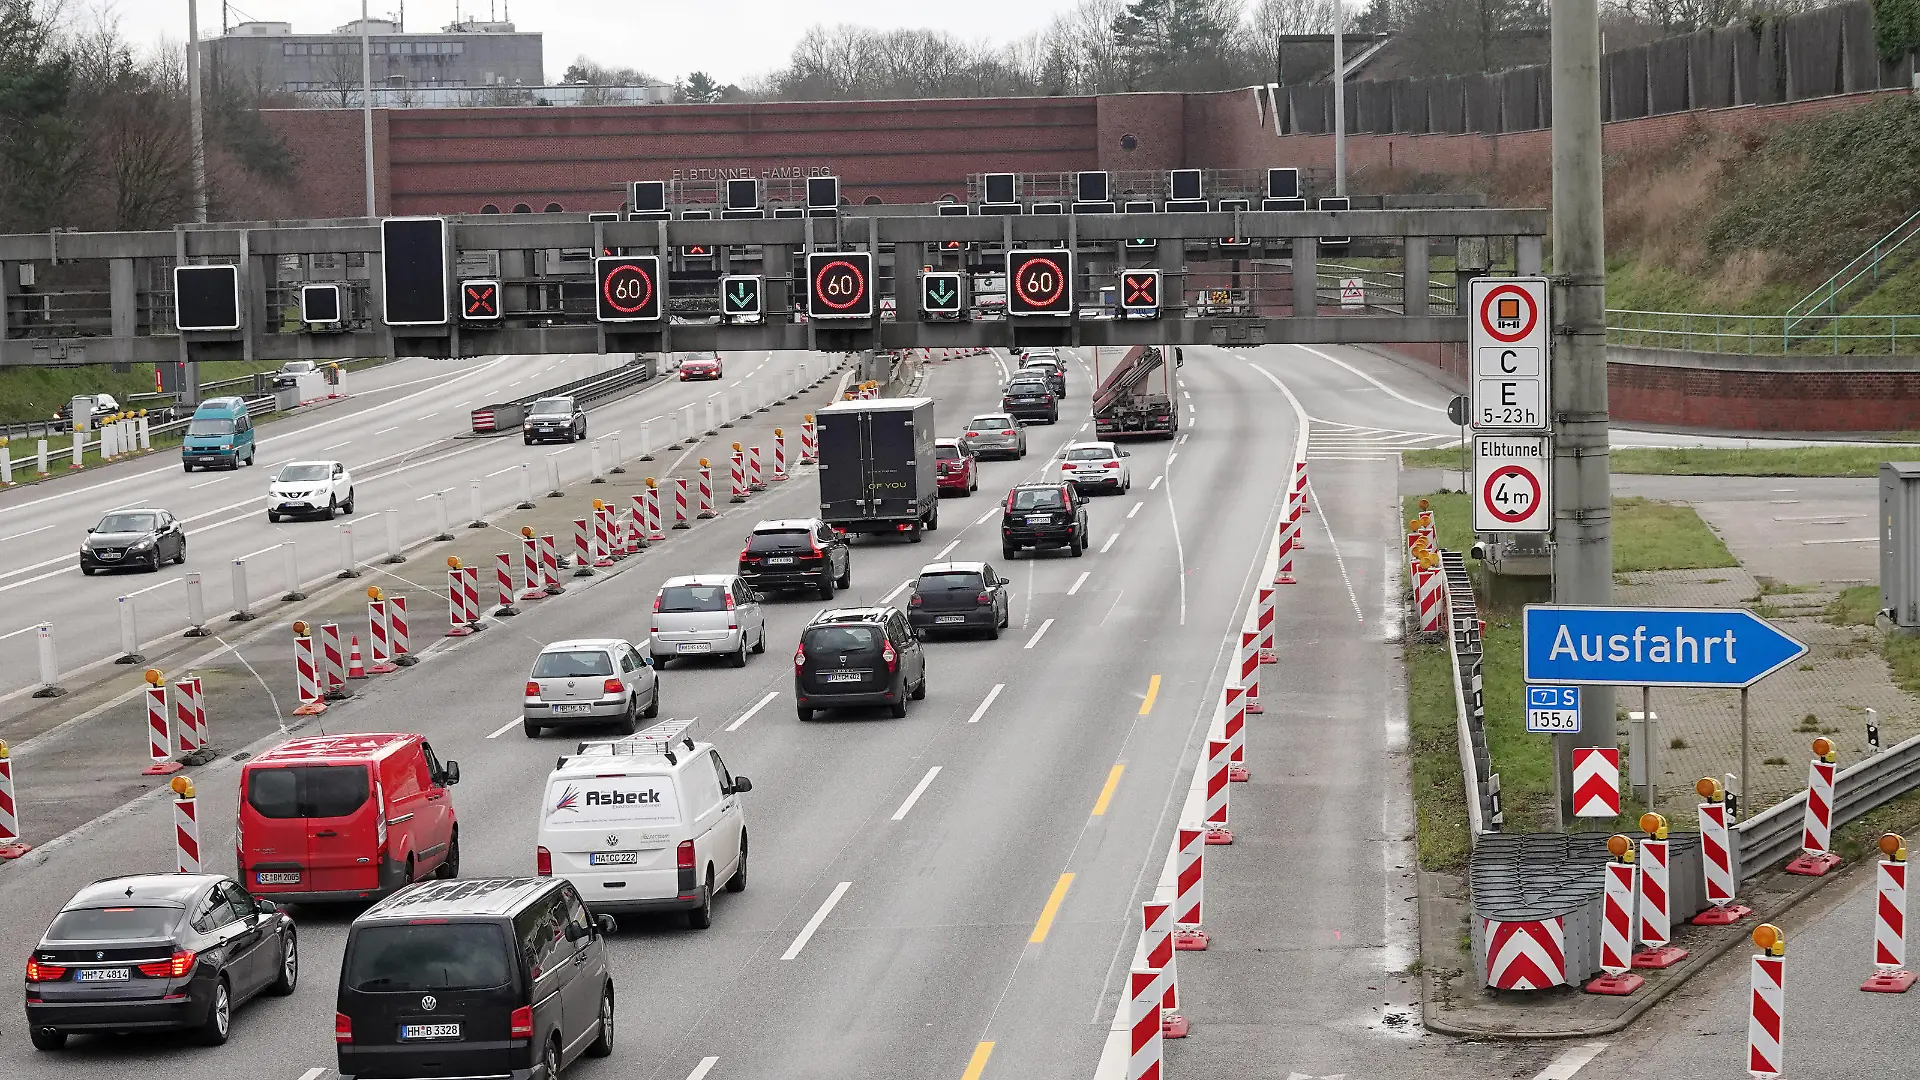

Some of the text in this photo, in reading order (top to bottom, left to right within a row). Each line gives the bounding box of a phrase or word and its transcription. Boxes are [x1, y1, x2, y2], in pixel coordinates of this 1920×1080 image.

[673, 166, 830, 180] ELBTUNNEL HAMBURG
[616, 278, 640, 298] 60
[828, 275, 853, 295] 60
[1027, 272, 1052, 293] 60
[1500, 350, 1517, 373] C
[1501, 382, 1517, 406] E
[1481, 441, 1542, 457] Elbtunnel
[1549, 624, 1737, 664] Ausfahrt
[1540, 690, 1575, 706] 7 S
[1532, 711, 1574, 729] 155,6
[586, 789, 661, 806] Asbeck
[621, 853, 636, 862] 222
[81, 968, 128, 981] HH Z 4814
[407, 1025, 458, 1036] HH B 3328
